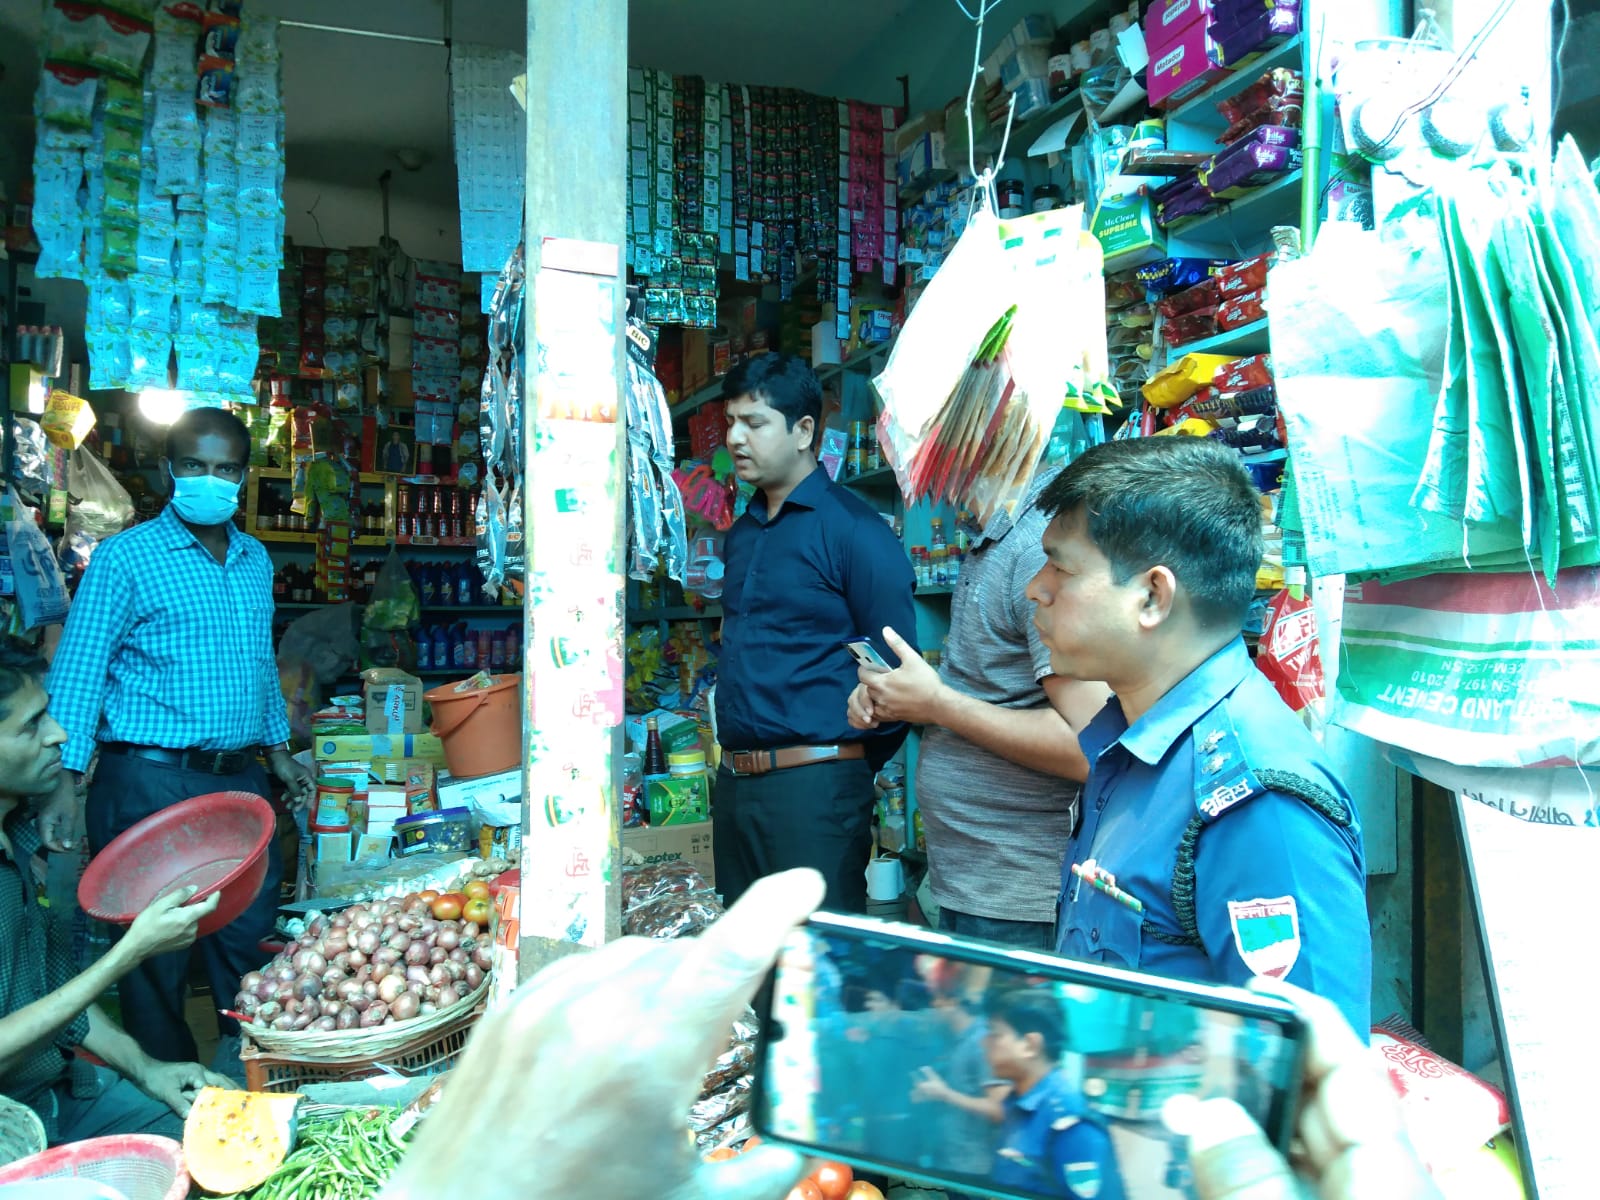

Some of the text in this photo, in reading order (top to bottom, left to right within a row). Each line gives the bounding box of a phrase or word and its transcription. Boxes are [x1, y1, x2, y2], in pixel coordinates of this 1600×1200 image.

[1156, 49, 1182, 73] Matador
[1098, 218, 1138, 239] SUPREME
[1376, 684, 1458, 715] CEMENT
